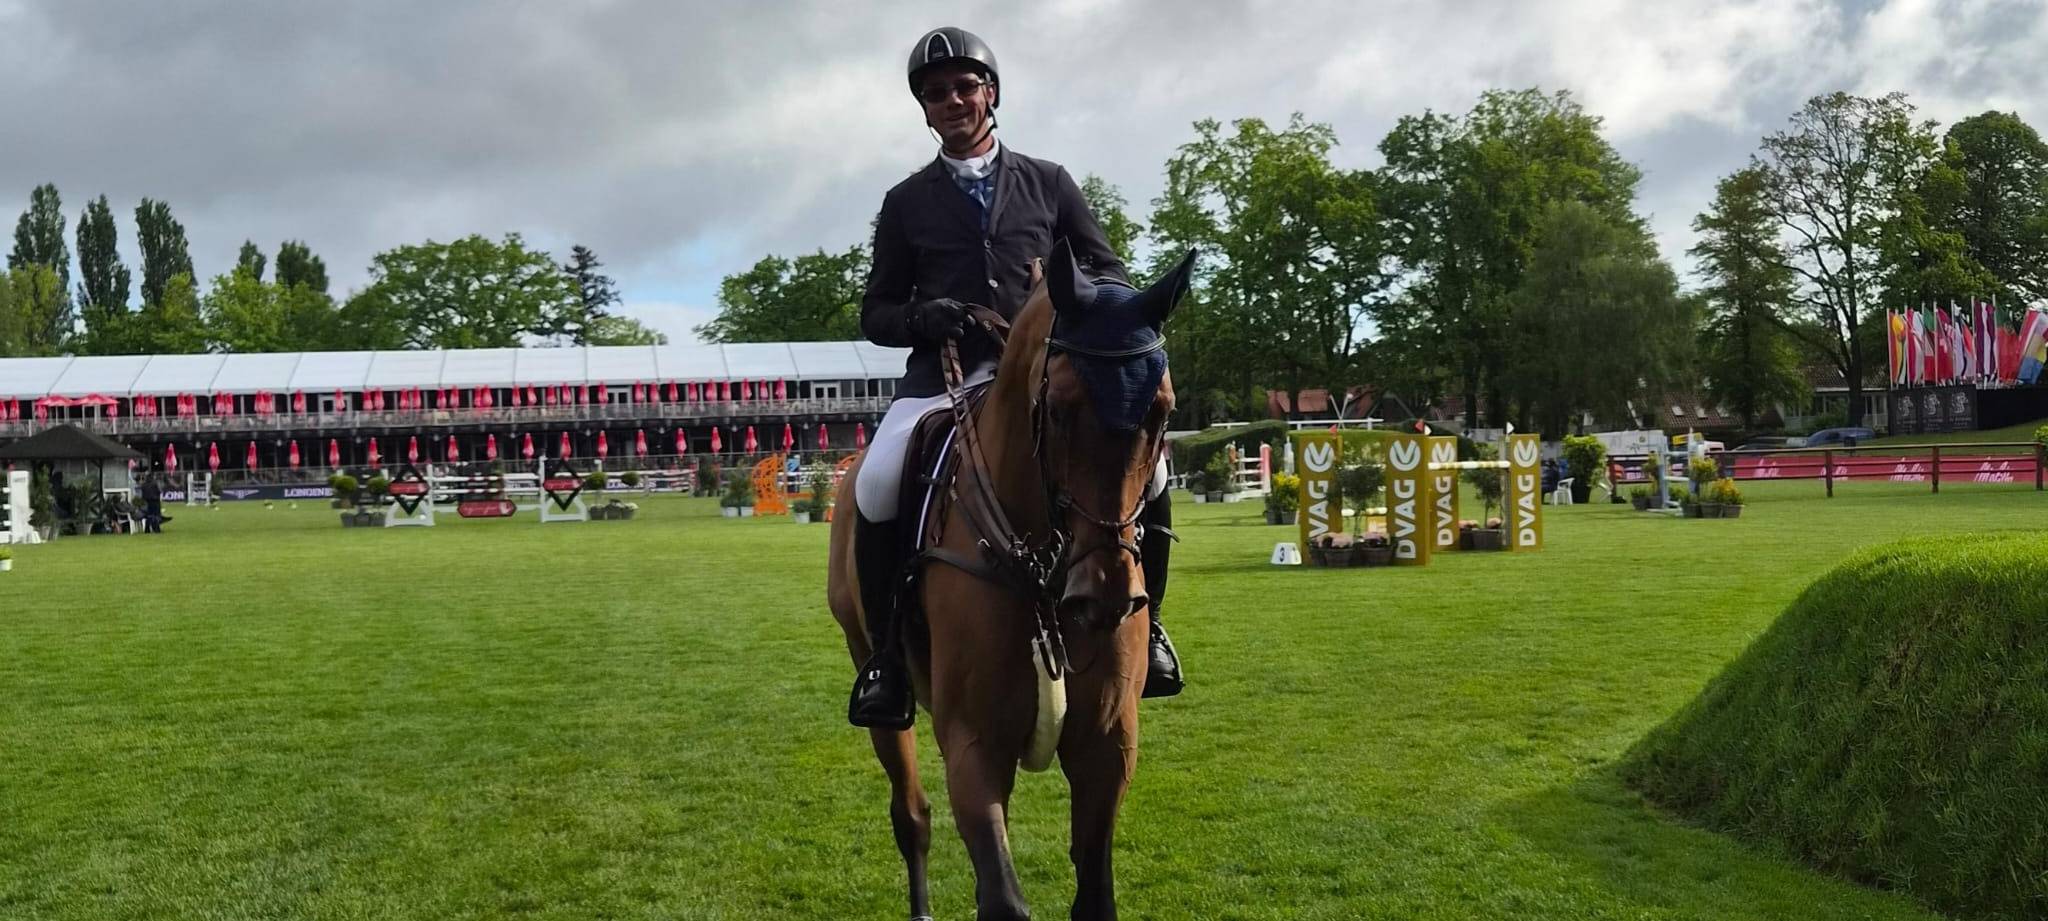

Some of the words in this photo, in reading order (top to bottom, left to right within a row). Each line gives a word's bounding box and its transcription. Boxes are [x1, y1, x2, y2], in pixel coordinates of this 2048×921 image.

[1394, 479, 1416, 559] DVAG
[1435, 475, 1451, 546] DVAG
[1517, 474, 1537, 546] DVAG
